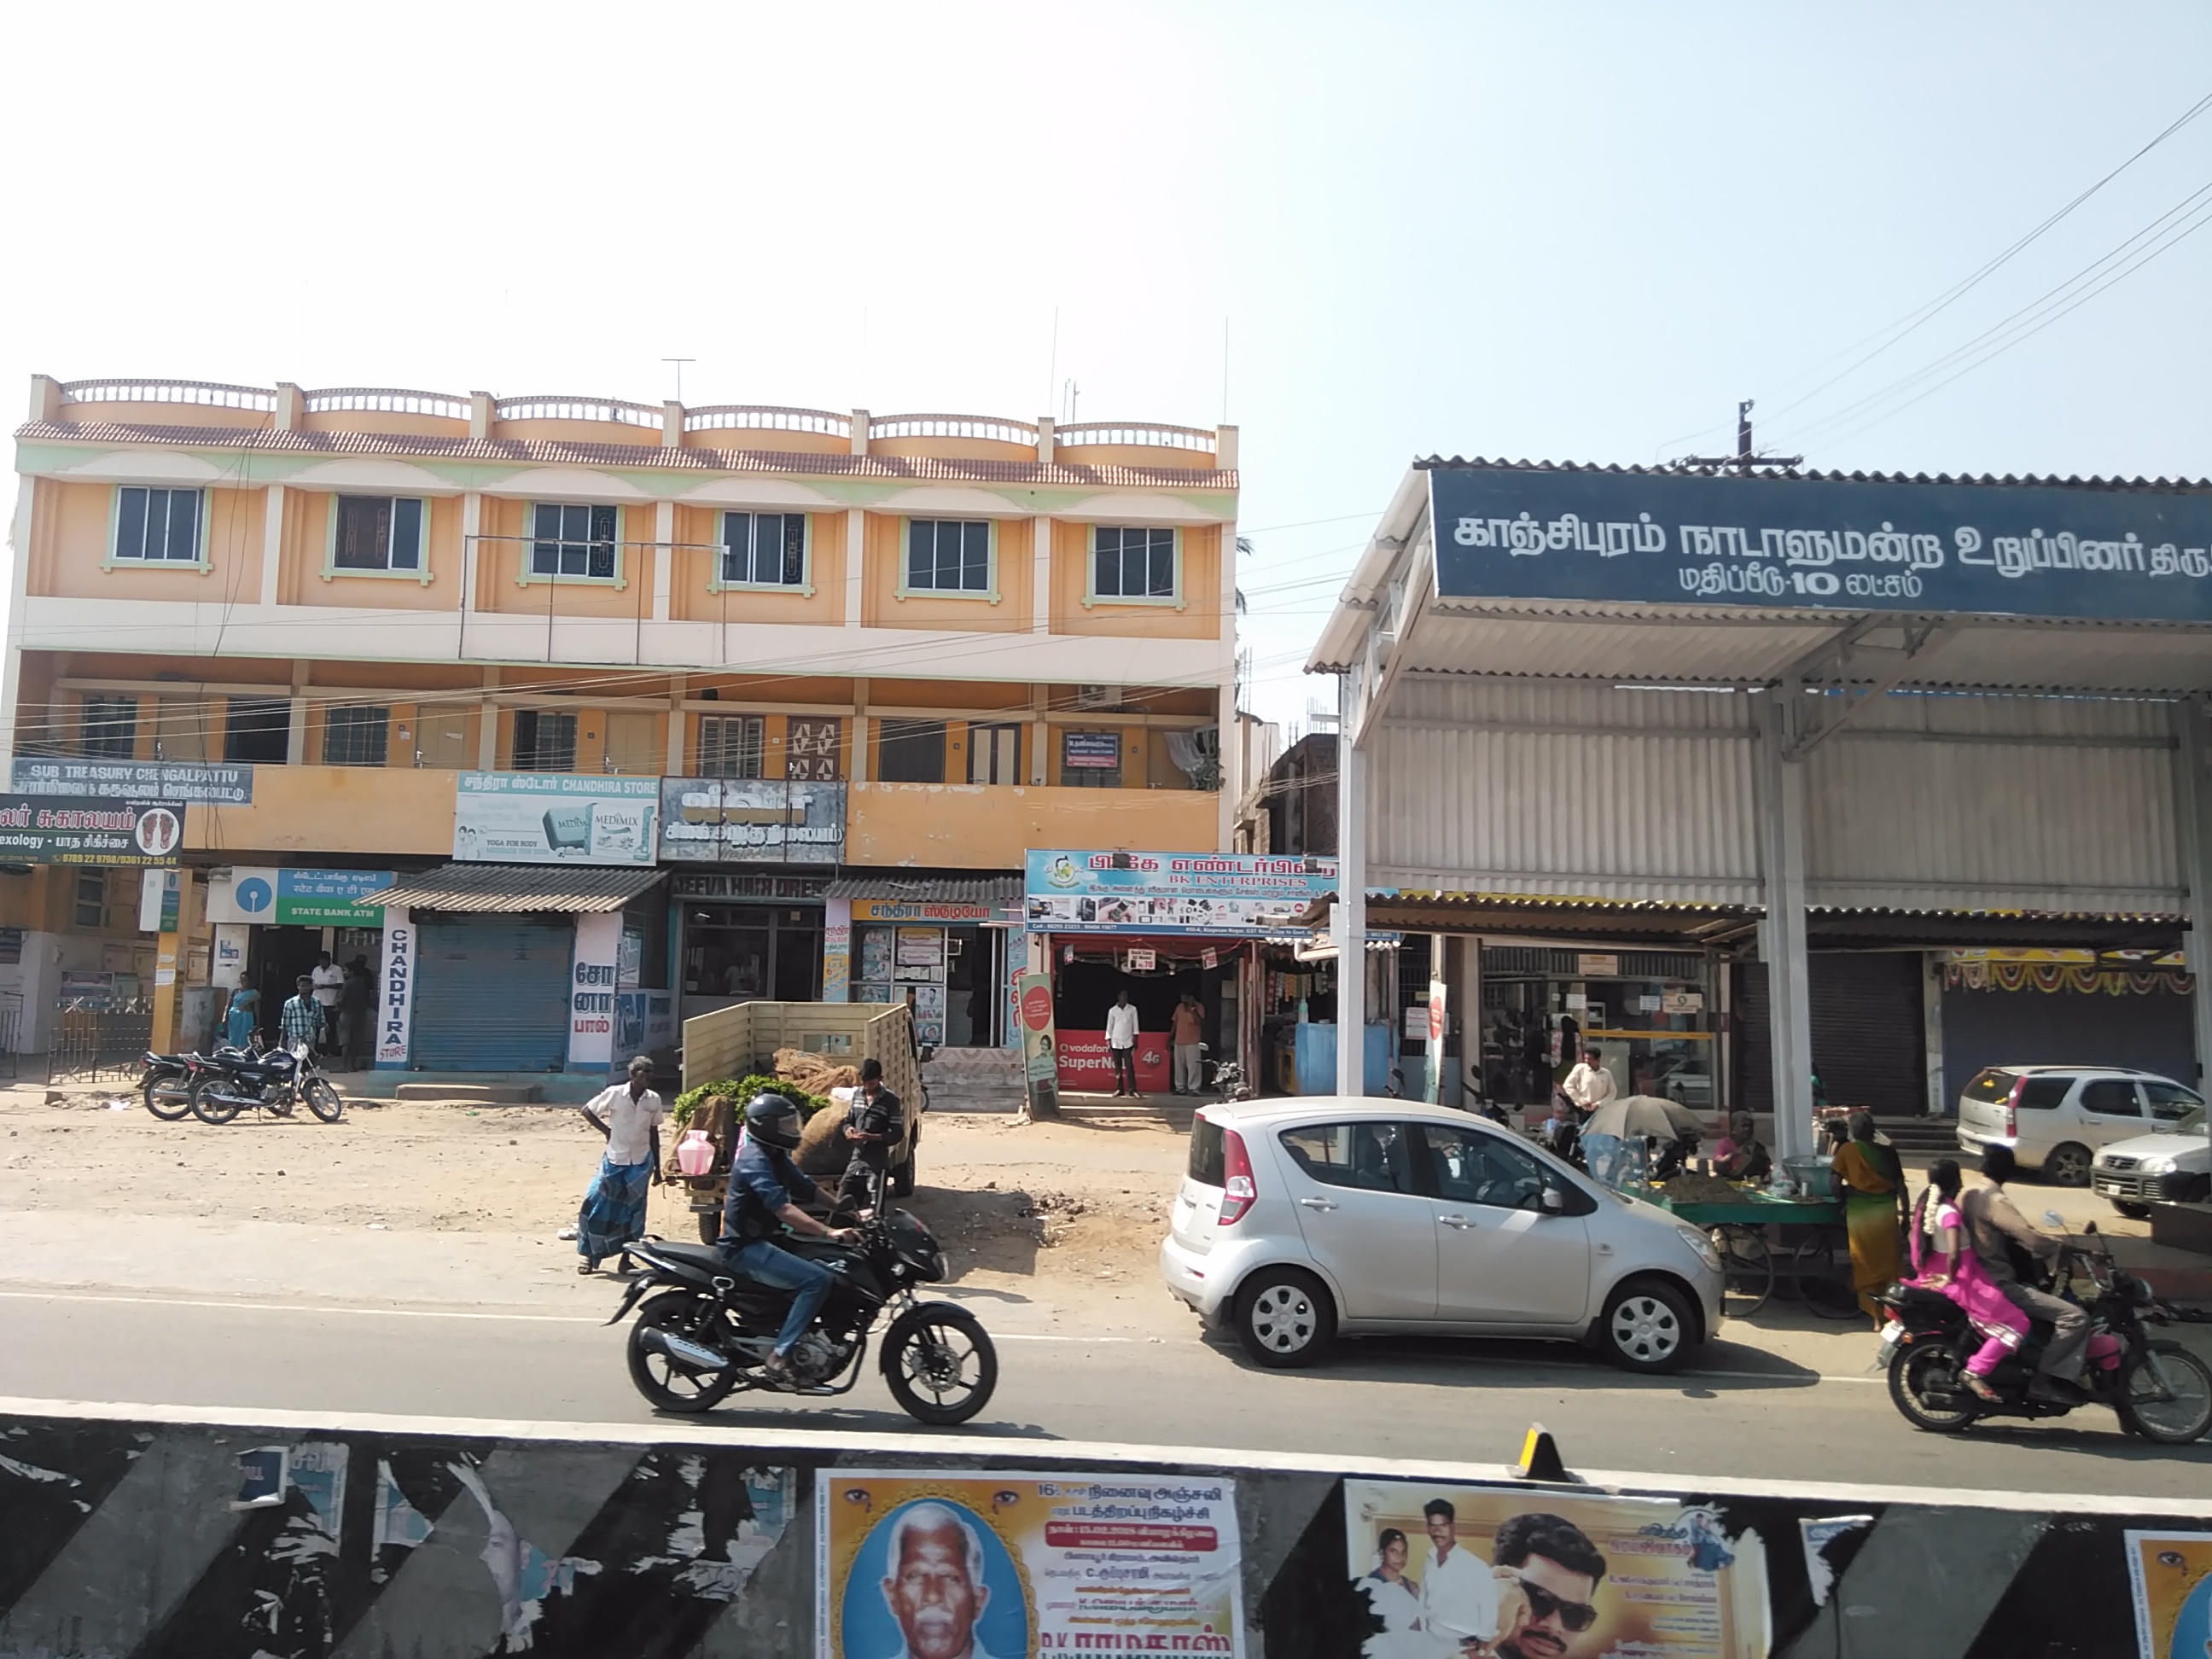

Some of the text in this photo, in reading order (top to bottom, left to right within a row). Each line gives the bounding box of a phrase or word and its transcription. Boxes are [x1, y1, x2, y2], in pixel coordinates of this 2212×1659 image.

[1453, 512, 1667, 557] காஞ்சிபுரம்
[1679, 521, 1945, 571] நாடாளுமன்ற
[1954, 526, 2146, 579] உறுப்பினர்
[1845, 569, 1924, 597] லட்சம்
[30, 765, 239, 783] SUB TREASURY CHENGALPATTU
[463, 774, 657, 795] சந்திரா ஸ்டோர் CHANDHIRA STORE
[37, 806, 137, 831] சுகாலயம்
[55, 836, 81, 849] பாத
[83, 834, 130, 849] சிகிச்சை
[486, 839, 504, 847] YOGA
[506, 839, 519, 847] FOR
[62, 854, 83, 864] 9789
[84, 855, 96, 864] 22
[142, 856, 153, 865] 22
[293, 884, 312, 894] स्टेट
[336, 887, 345, 895] ए
[1169, 875, 1307, 888] BK ENTERPRISES
[291, 906, 375, 917] STATE BANK ATM
[870, 901, 992, 920] சந்திரா ஸ்டுடியோ
[574, 961, 615, 987] சோ
[384, 929, 408, 1045] CHANDHIRA
[573, 1016, 610, 1033] பால்
[379, 1045, 407, 1061] STORE
[1069, 1043, 1110, 1054] vodafon
[1142, 1051, 1161, 1064] 4G
[1088, 1483, 1153, 1501] நினைவு
[1153, 1487, 1222, 1503] அஞ்சலி
